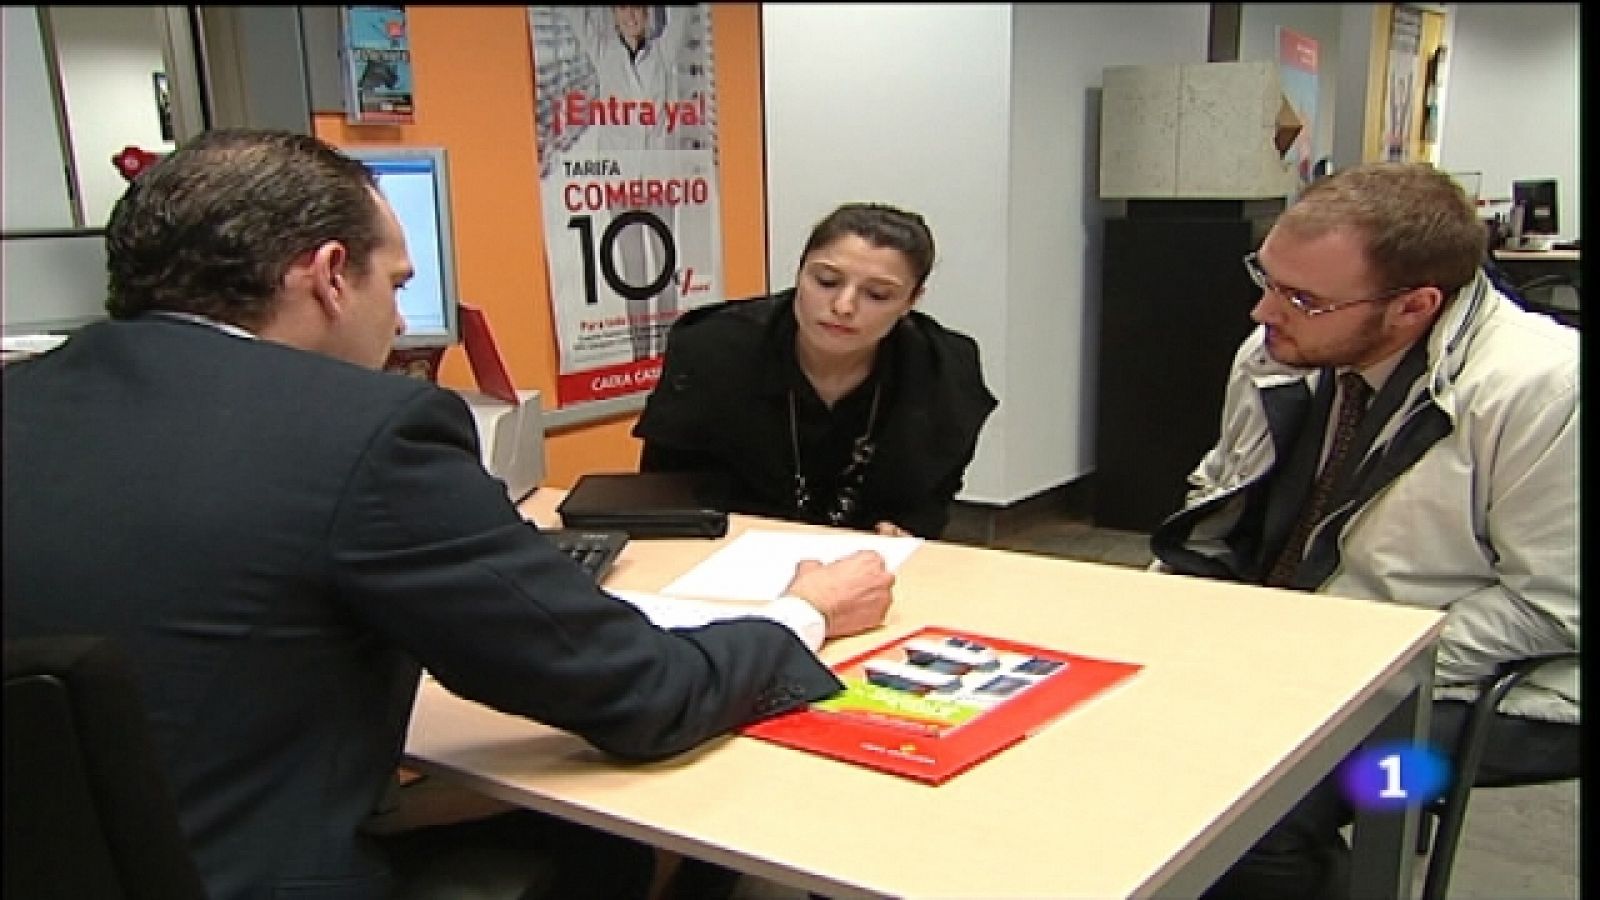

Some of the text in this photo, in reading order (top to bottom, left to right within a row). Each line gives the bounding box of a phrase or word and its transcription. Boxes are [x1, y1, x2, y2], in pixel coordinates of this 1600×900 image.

[551, 90, 706, 136] ¡Entra ya!
[562, 160, 621, 176] TARIFA
[564, 177, 709, 212] COMERCIO
[591, 373, 633, 391] CAIXA
